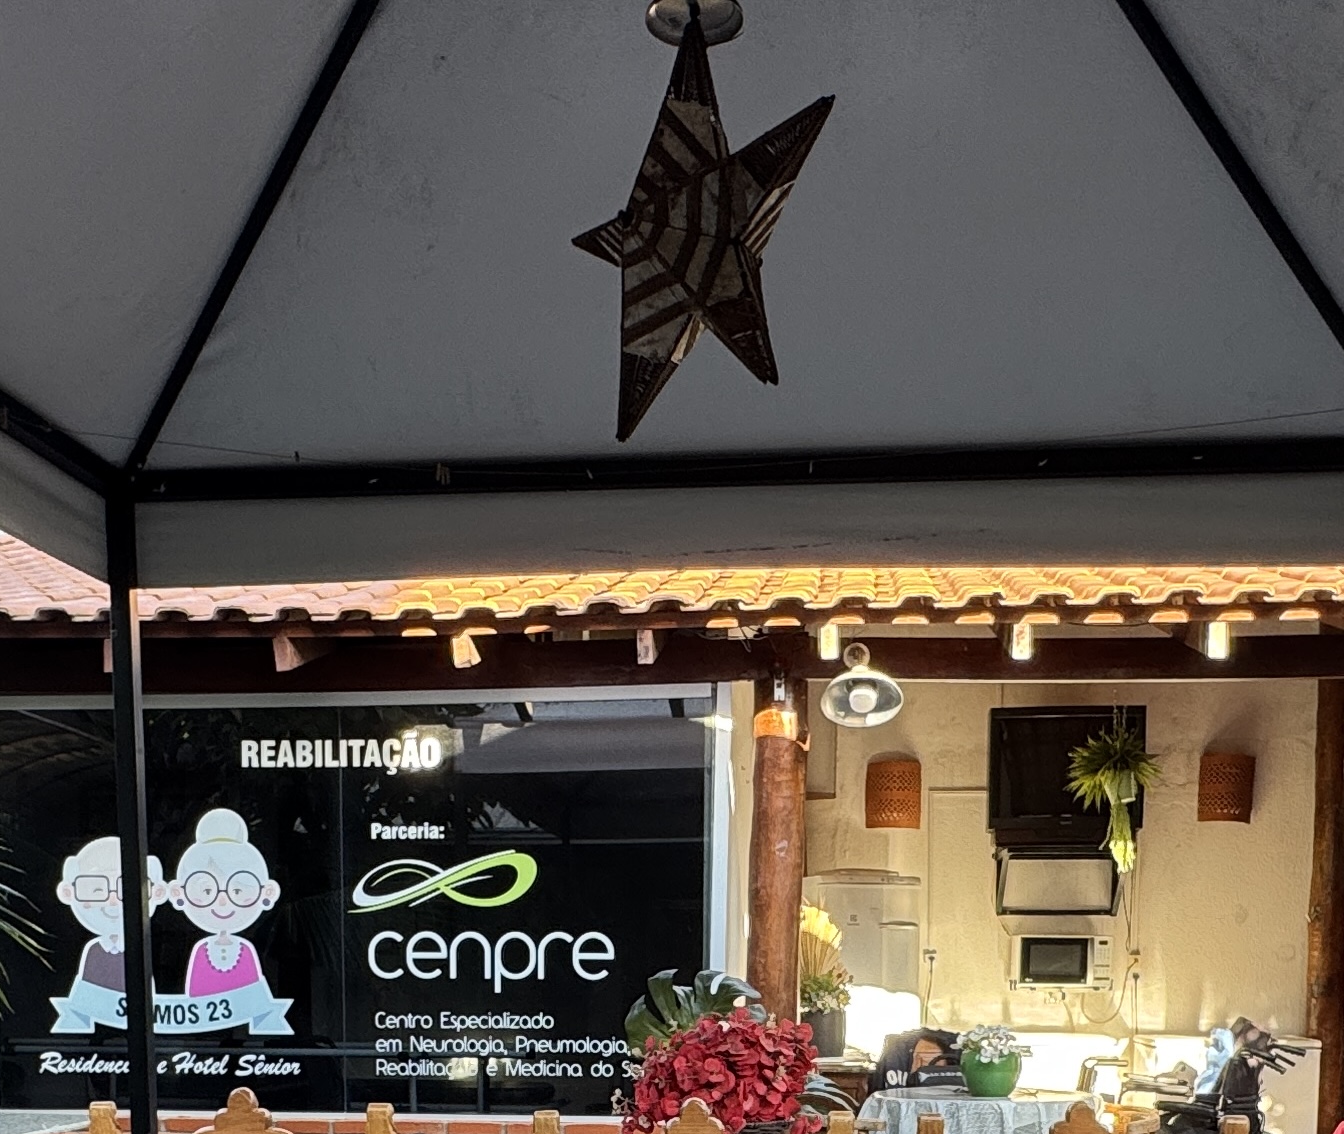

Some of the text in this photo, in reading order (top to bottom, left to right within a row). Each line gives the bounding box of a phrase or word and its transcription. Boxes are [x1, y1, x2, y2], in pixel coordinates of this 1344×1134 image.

[241, 730, 442, 776] REABILITAÇÃO
[370, 821, 446, 840] Parceria:
[368, 930, 616, 994] cenpre
[116, 997, 233, 1025] SMOS 23
[374, 1011, 555, 1033] Centro Especializado
[375, 1035, 632, 1058] em Neurologia, Pneumologia,
[156, 1060, 168, 1074] e
[171, 1051, 228, 1075] Hotel
[234, 1051, 302, 1077] Sênior
[485, 1062, 499, 1077] e
[505, 1059, 583, 1077] Medicina
[590, 1060, 615, 1077] do
